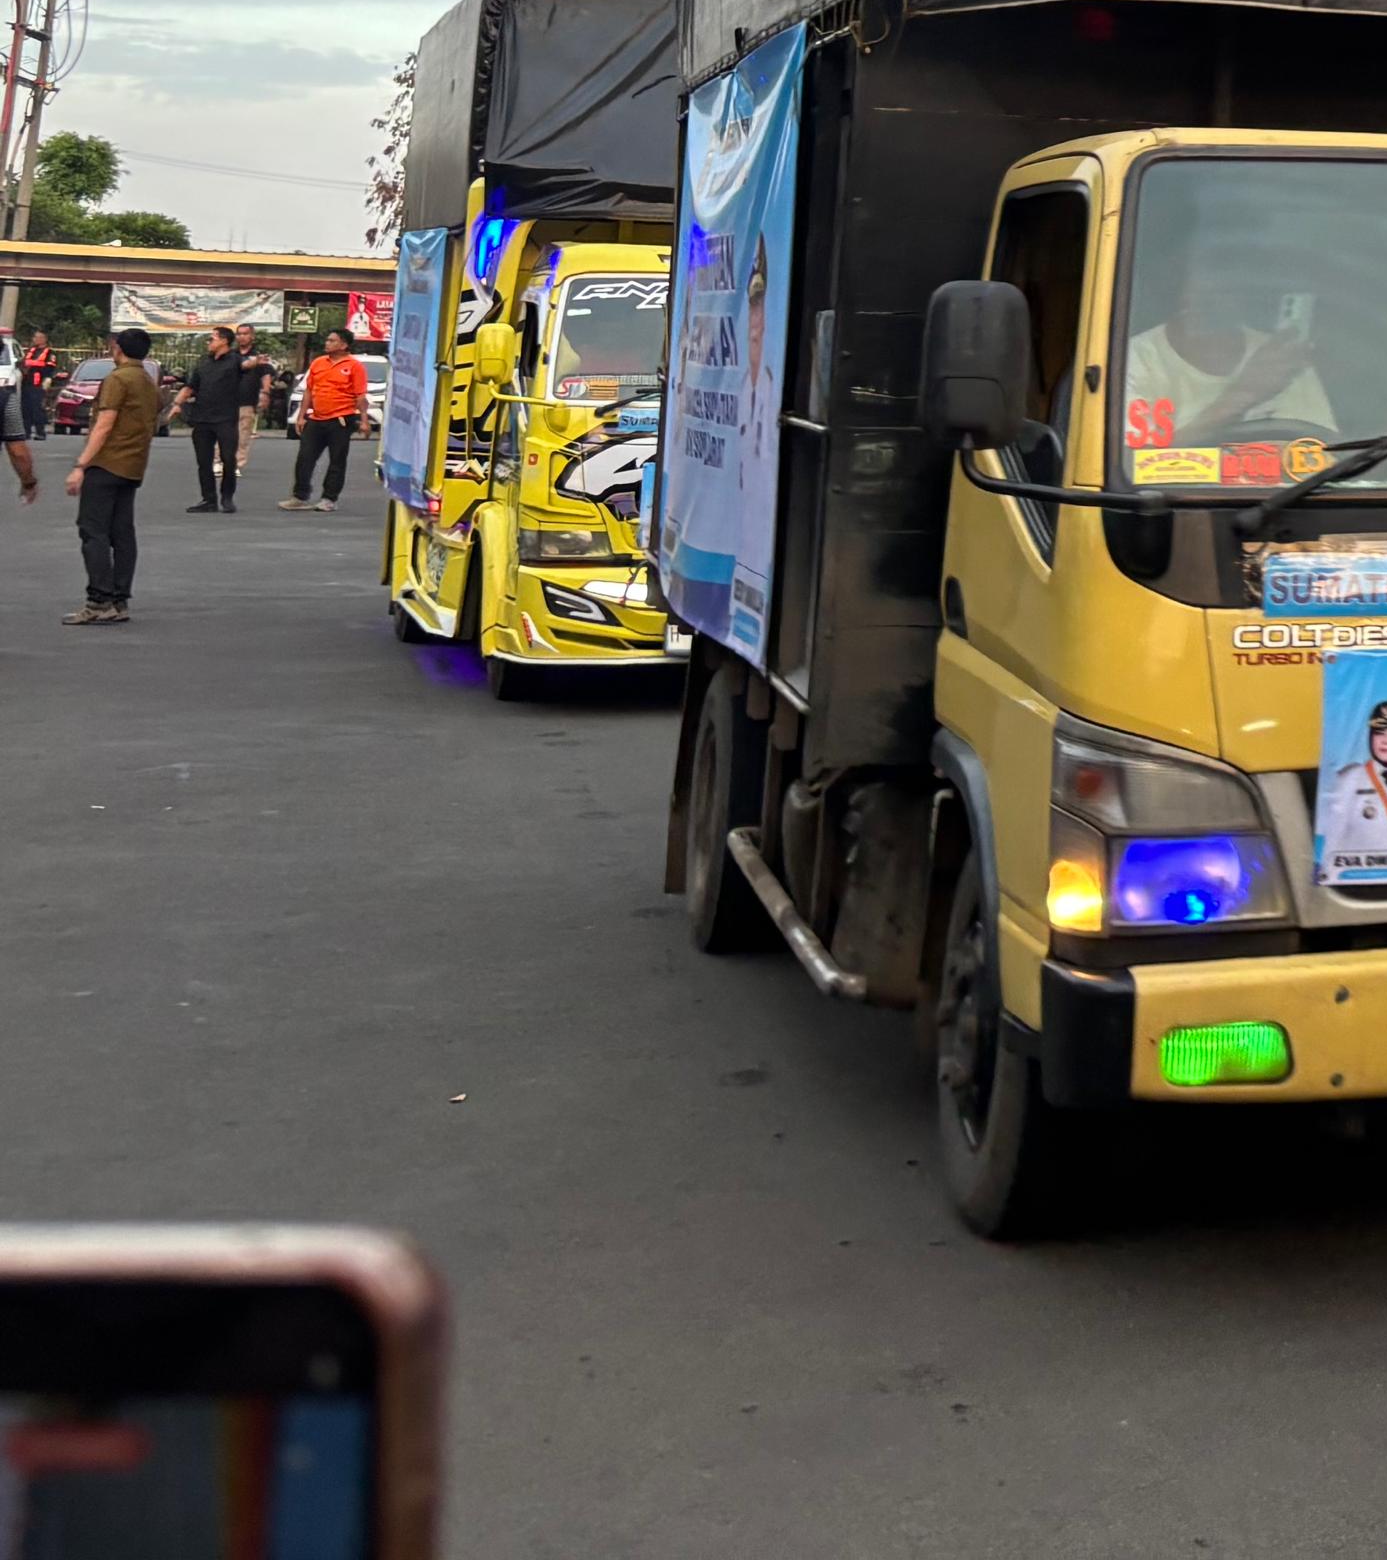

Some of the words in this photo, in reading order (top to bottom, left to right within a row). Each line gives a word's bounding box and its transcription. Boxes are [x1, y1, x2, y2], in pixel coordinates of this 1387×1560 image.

[1125, 398, 1175, 449] SS
[1233, 652, 1303, 666] TURBO
[1333, 855, 1362, 868] EVA
